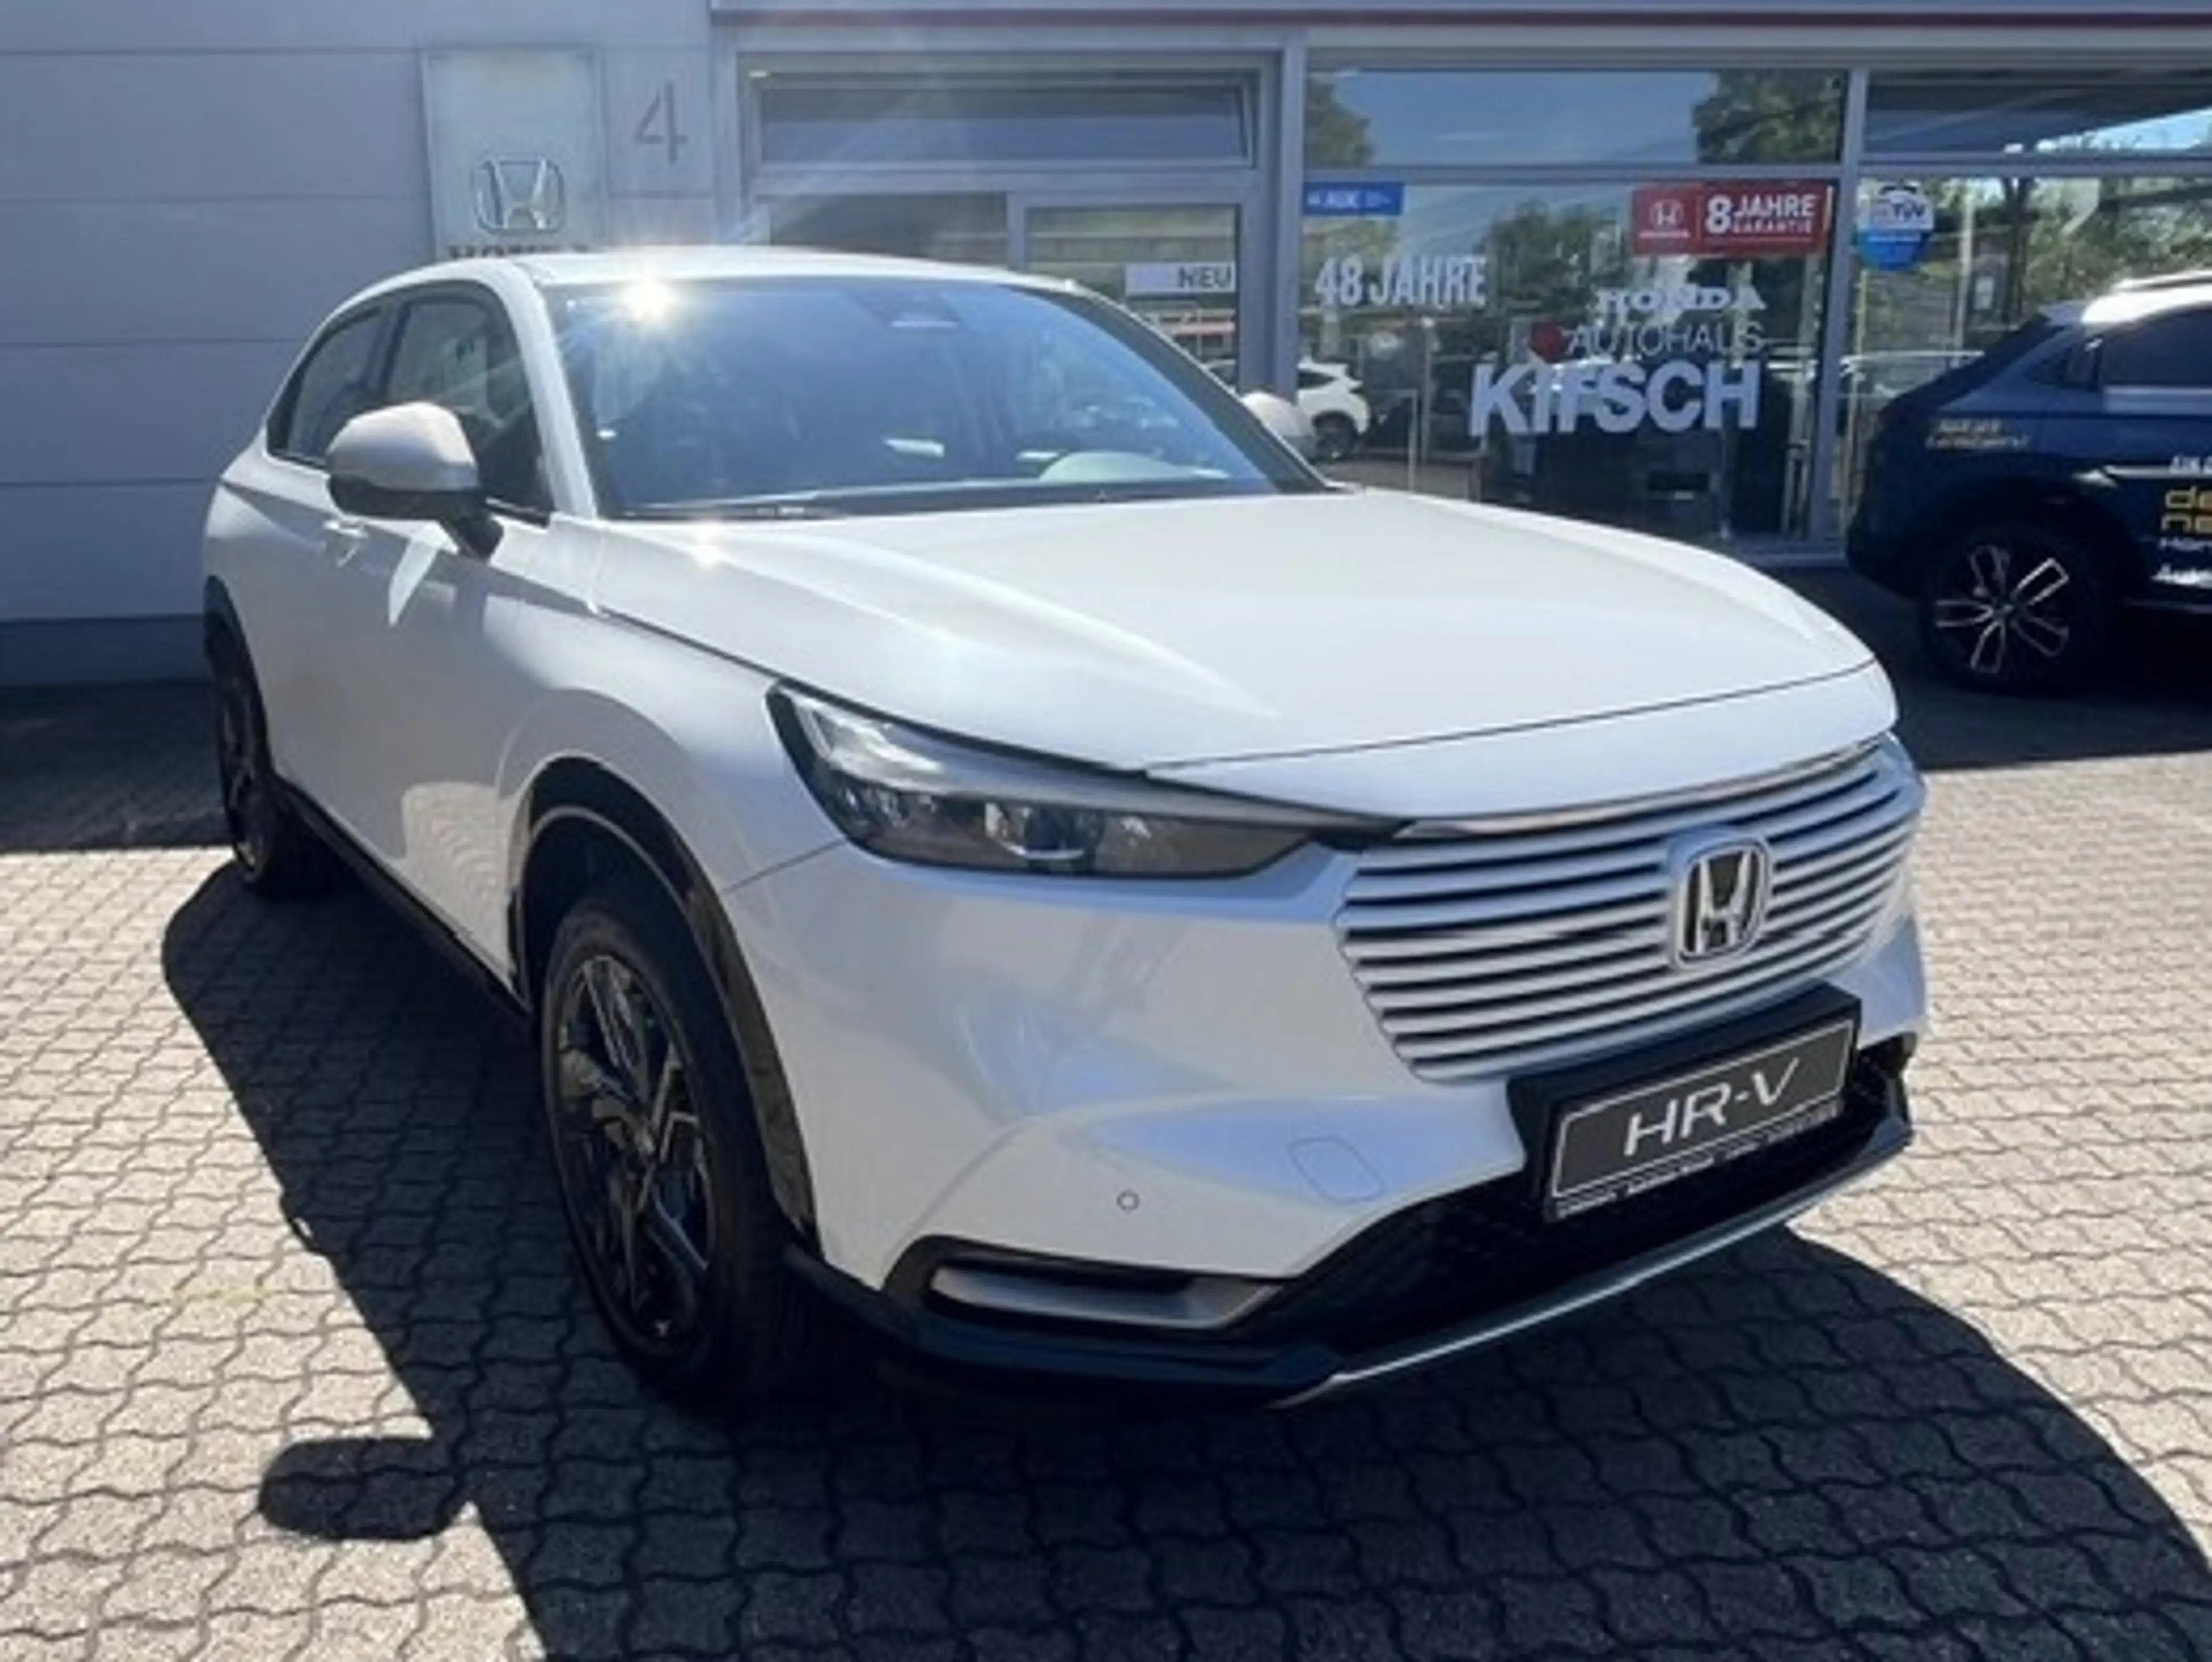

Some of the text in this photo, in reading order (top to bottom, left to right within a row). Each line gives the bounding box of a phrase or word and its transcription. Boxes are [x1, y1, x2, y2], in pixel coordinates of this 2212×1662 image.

[633, 80, 688, 164] 4
[1705, 194, 1817, 234] 8 JAHRE
[1179, 266, 1232, 289] NEU
[1314, 255, 1486, 308] 48 JAHRE
[1624, 1057, 1800, 1156] HR-V
